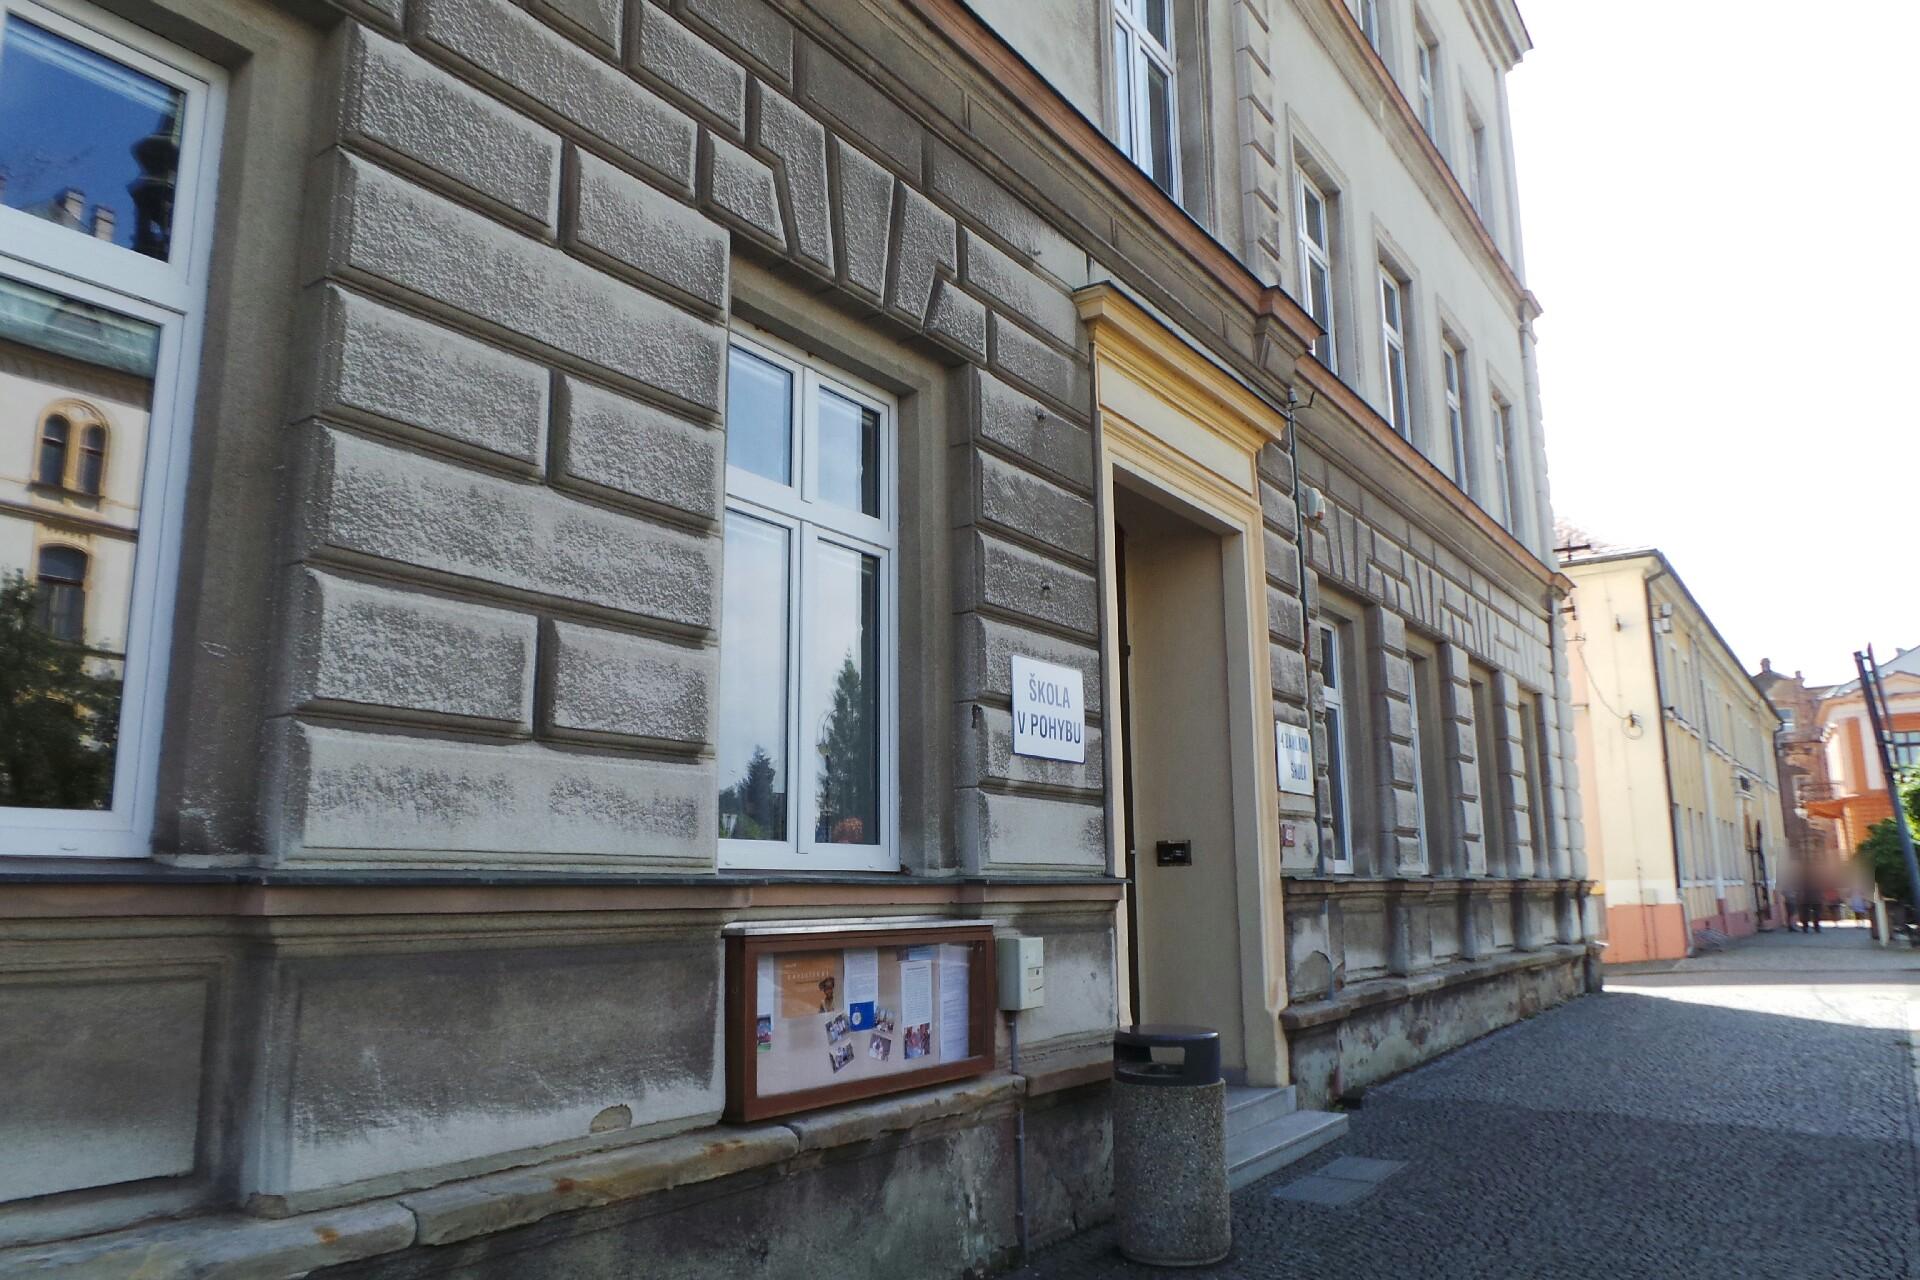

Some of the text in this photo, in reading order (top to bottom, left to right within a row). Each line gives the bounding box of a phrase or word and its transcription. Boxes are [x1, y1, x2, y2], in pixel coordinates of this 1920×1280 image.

[1029, 673, 1071, 709] ŠKOLA
[1017, 710, 1081, 744] V POHYBU
